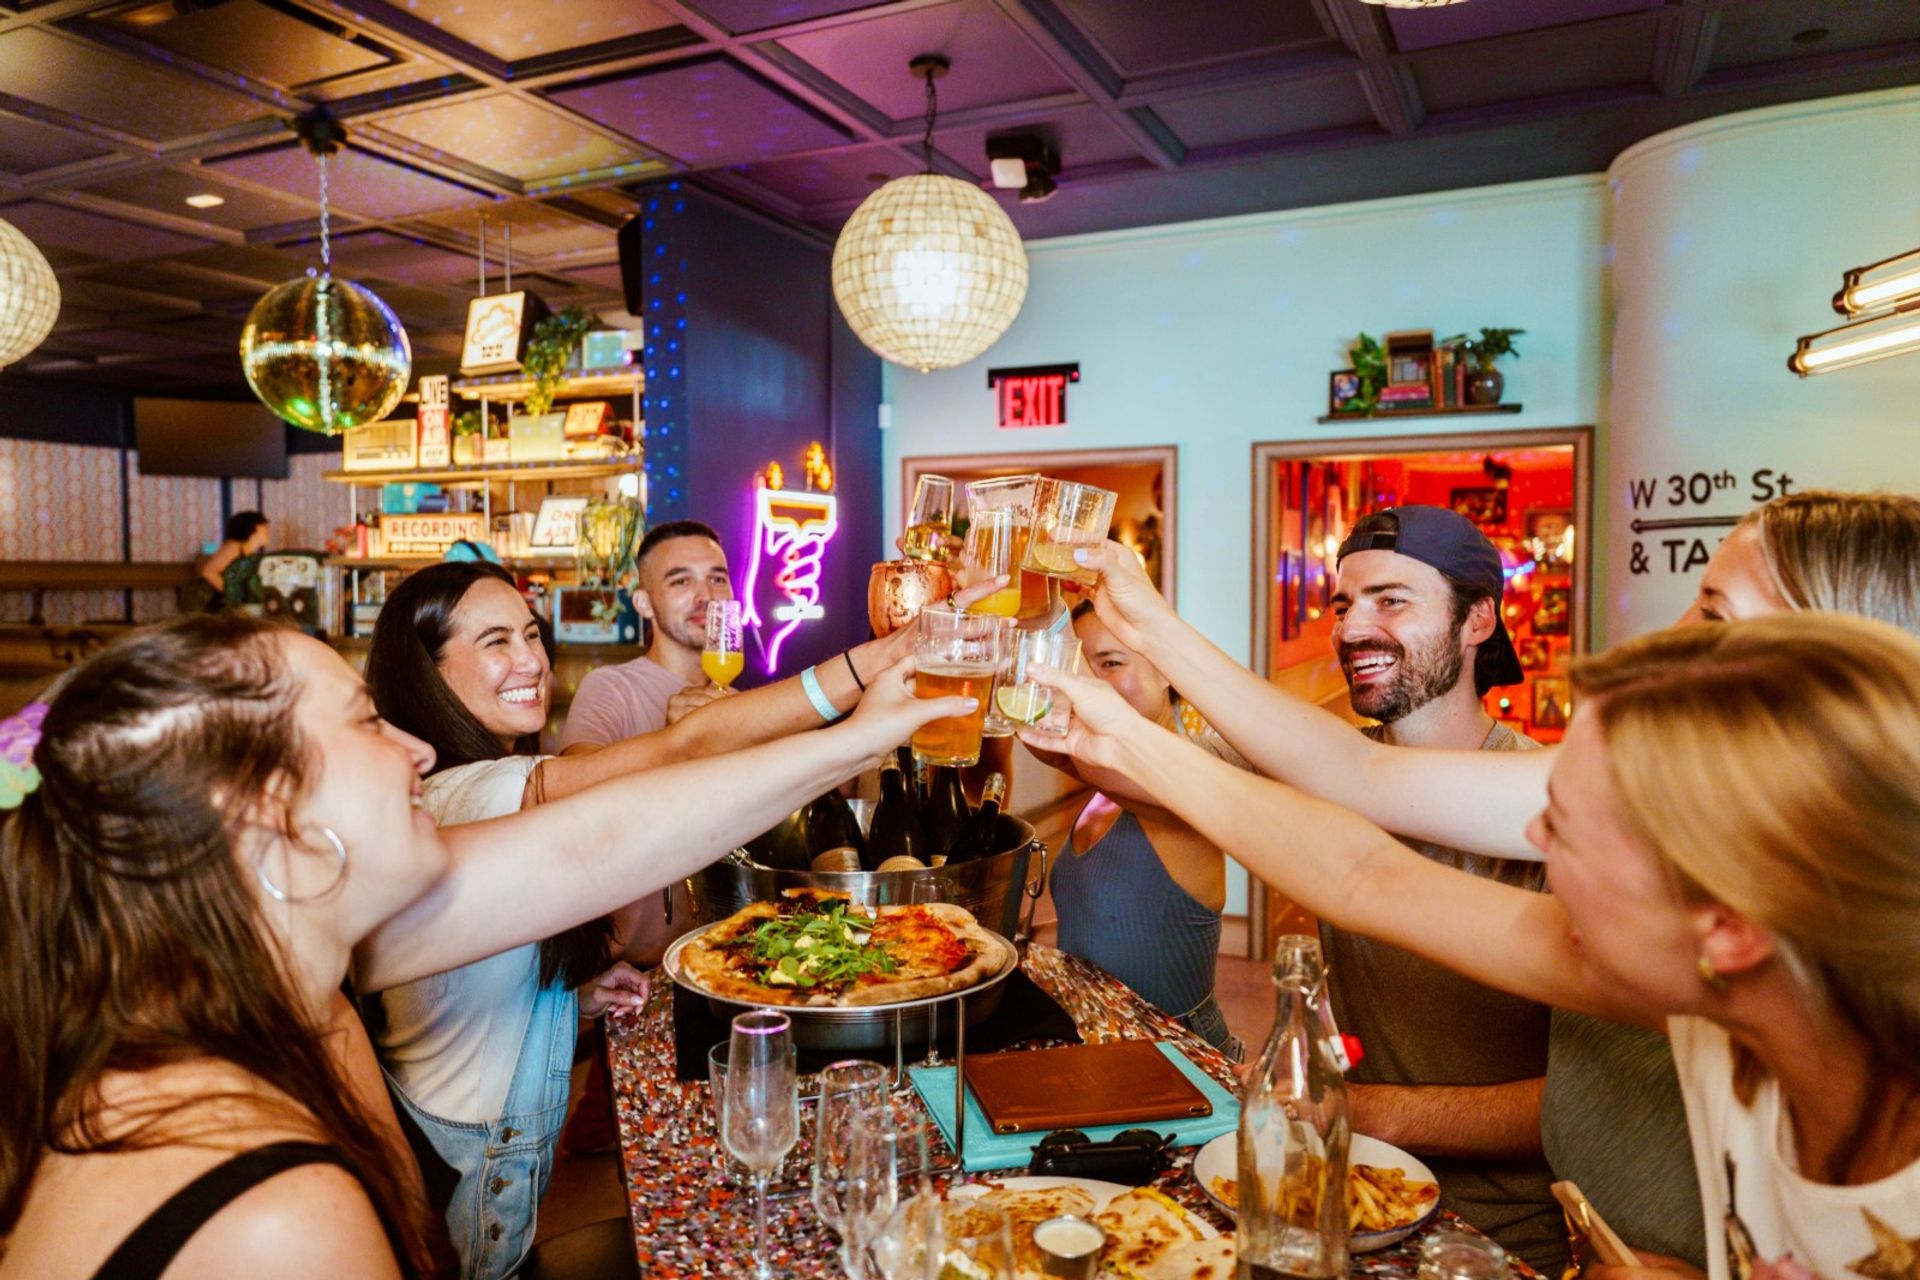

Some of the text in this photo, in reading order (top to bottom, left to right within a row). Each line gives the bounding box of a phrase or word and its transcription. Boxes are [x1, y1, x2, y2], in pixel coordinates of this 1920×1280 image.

[420, 381, 447, 404] LIVE
[1004, 376, 1064, 427] EXIT
[1630, 468, 1793, 509] W 30th St
[391, 522, 479, 537] RECORDING
[1629, 538, 1725, 575] & TA
